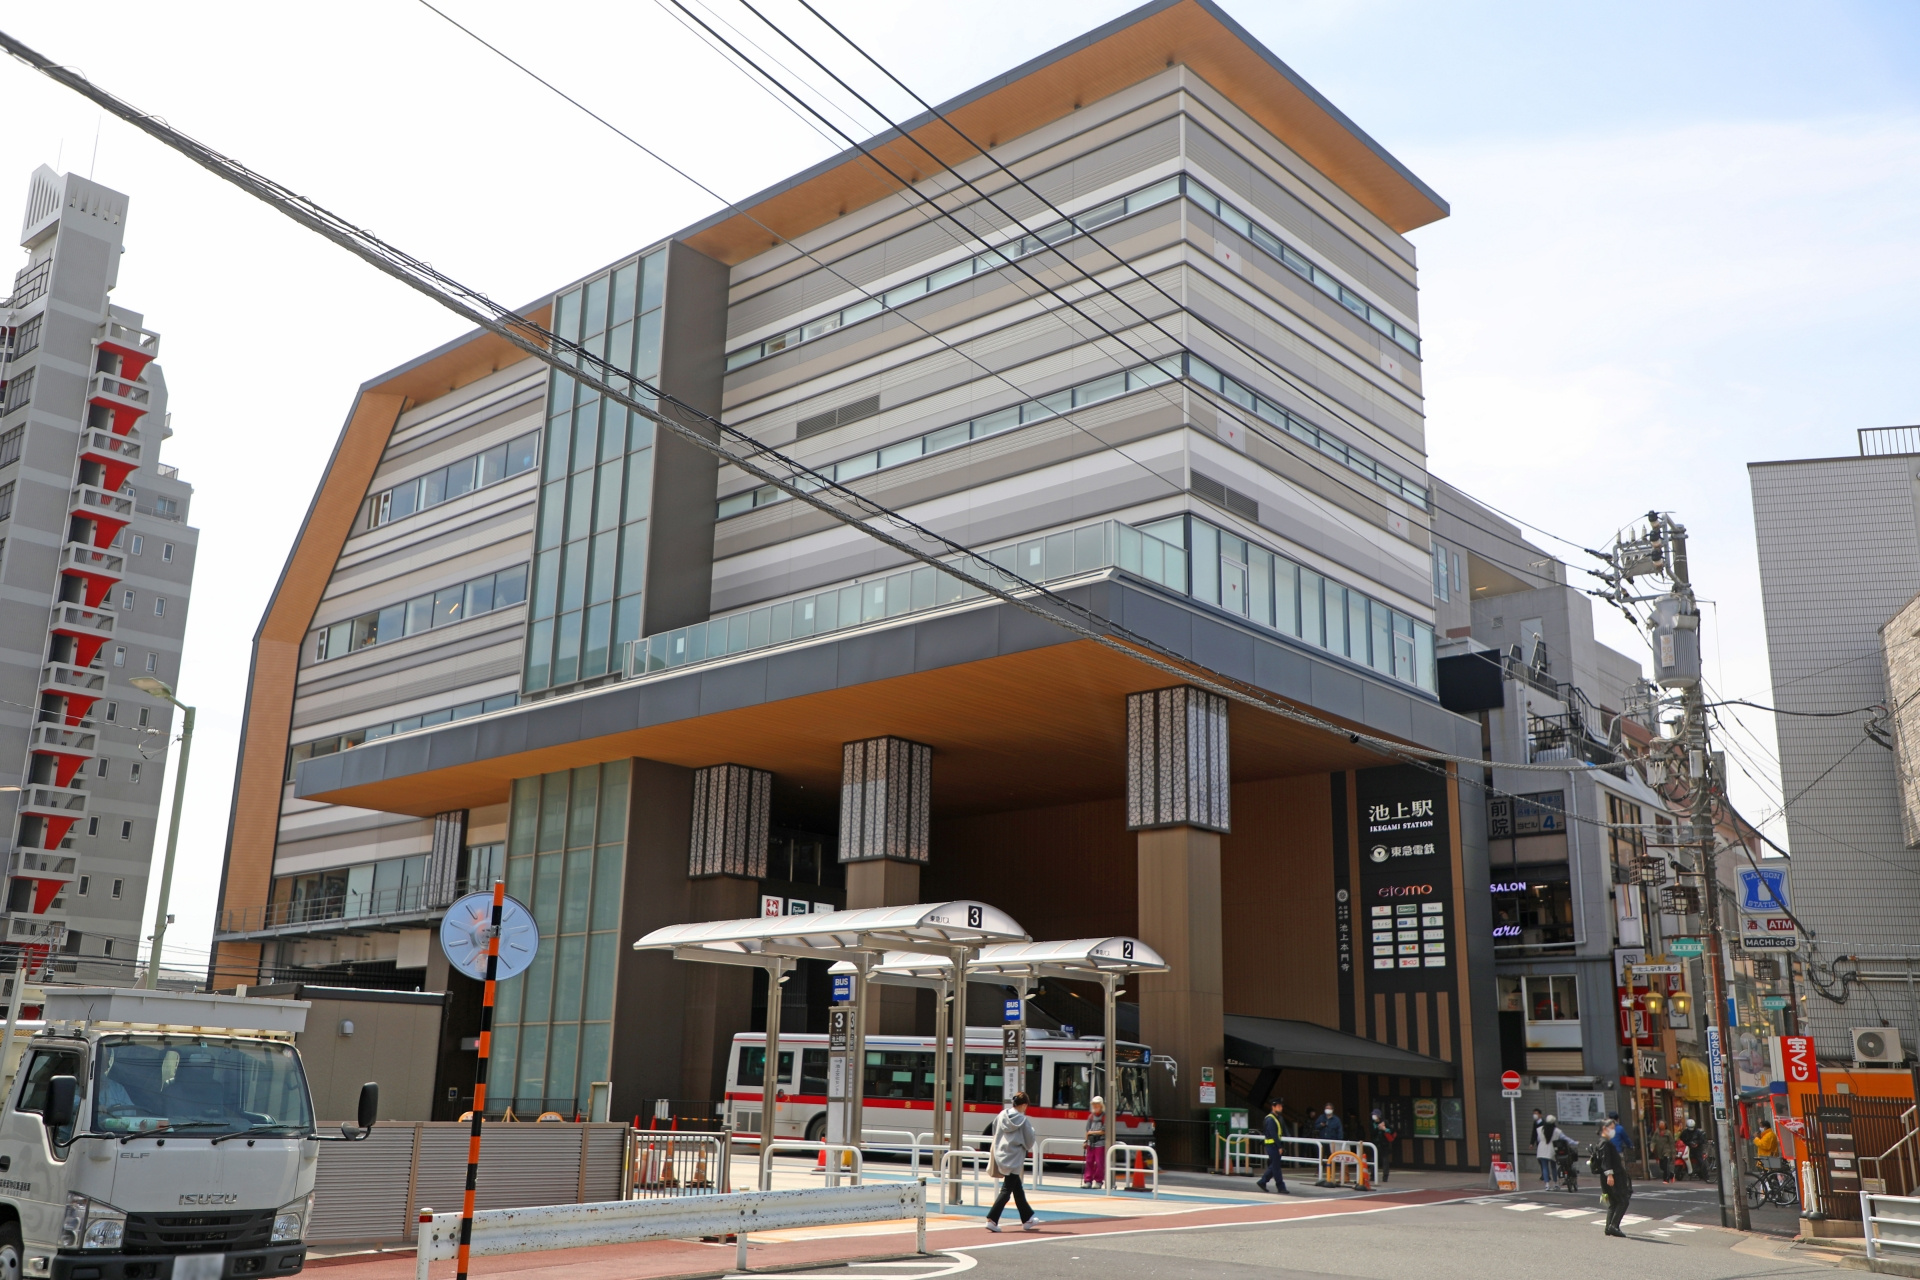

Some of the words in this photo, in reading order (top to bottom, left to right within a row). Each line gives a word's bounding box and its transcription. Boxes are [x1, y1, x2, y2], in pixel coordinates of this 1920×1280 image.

[1368, 799, 1434, 822] 池上駅
[1369, 823, 1401, 833] IKEGAMI
[1402, 819, 1434, 829] STATION
[1390, 843, 1435, 857] 東急電鉄
[1378, 884, 1433, 897] etomo
[1490, 882, 1526, 892] SALON
[970, 908, 980, 926] 3
[1768, 920, 1793, 929] ATM
[1745, 938, 1774, 946] MACHI
[1124, 942, 1132, 958] 2
[834, 978, 849, 986] BUS
[1006, 1001, 1019, 1009] BUS
[835, 1012, 844, 1028] 3
[1008, 1030, 1016, 1043] 2
[1642, 1057, 1658, 1074] KFC
[1787, 1038, 1809, 1081] 宝くじ
[178, 1193, 237, 1205] ISUZU
